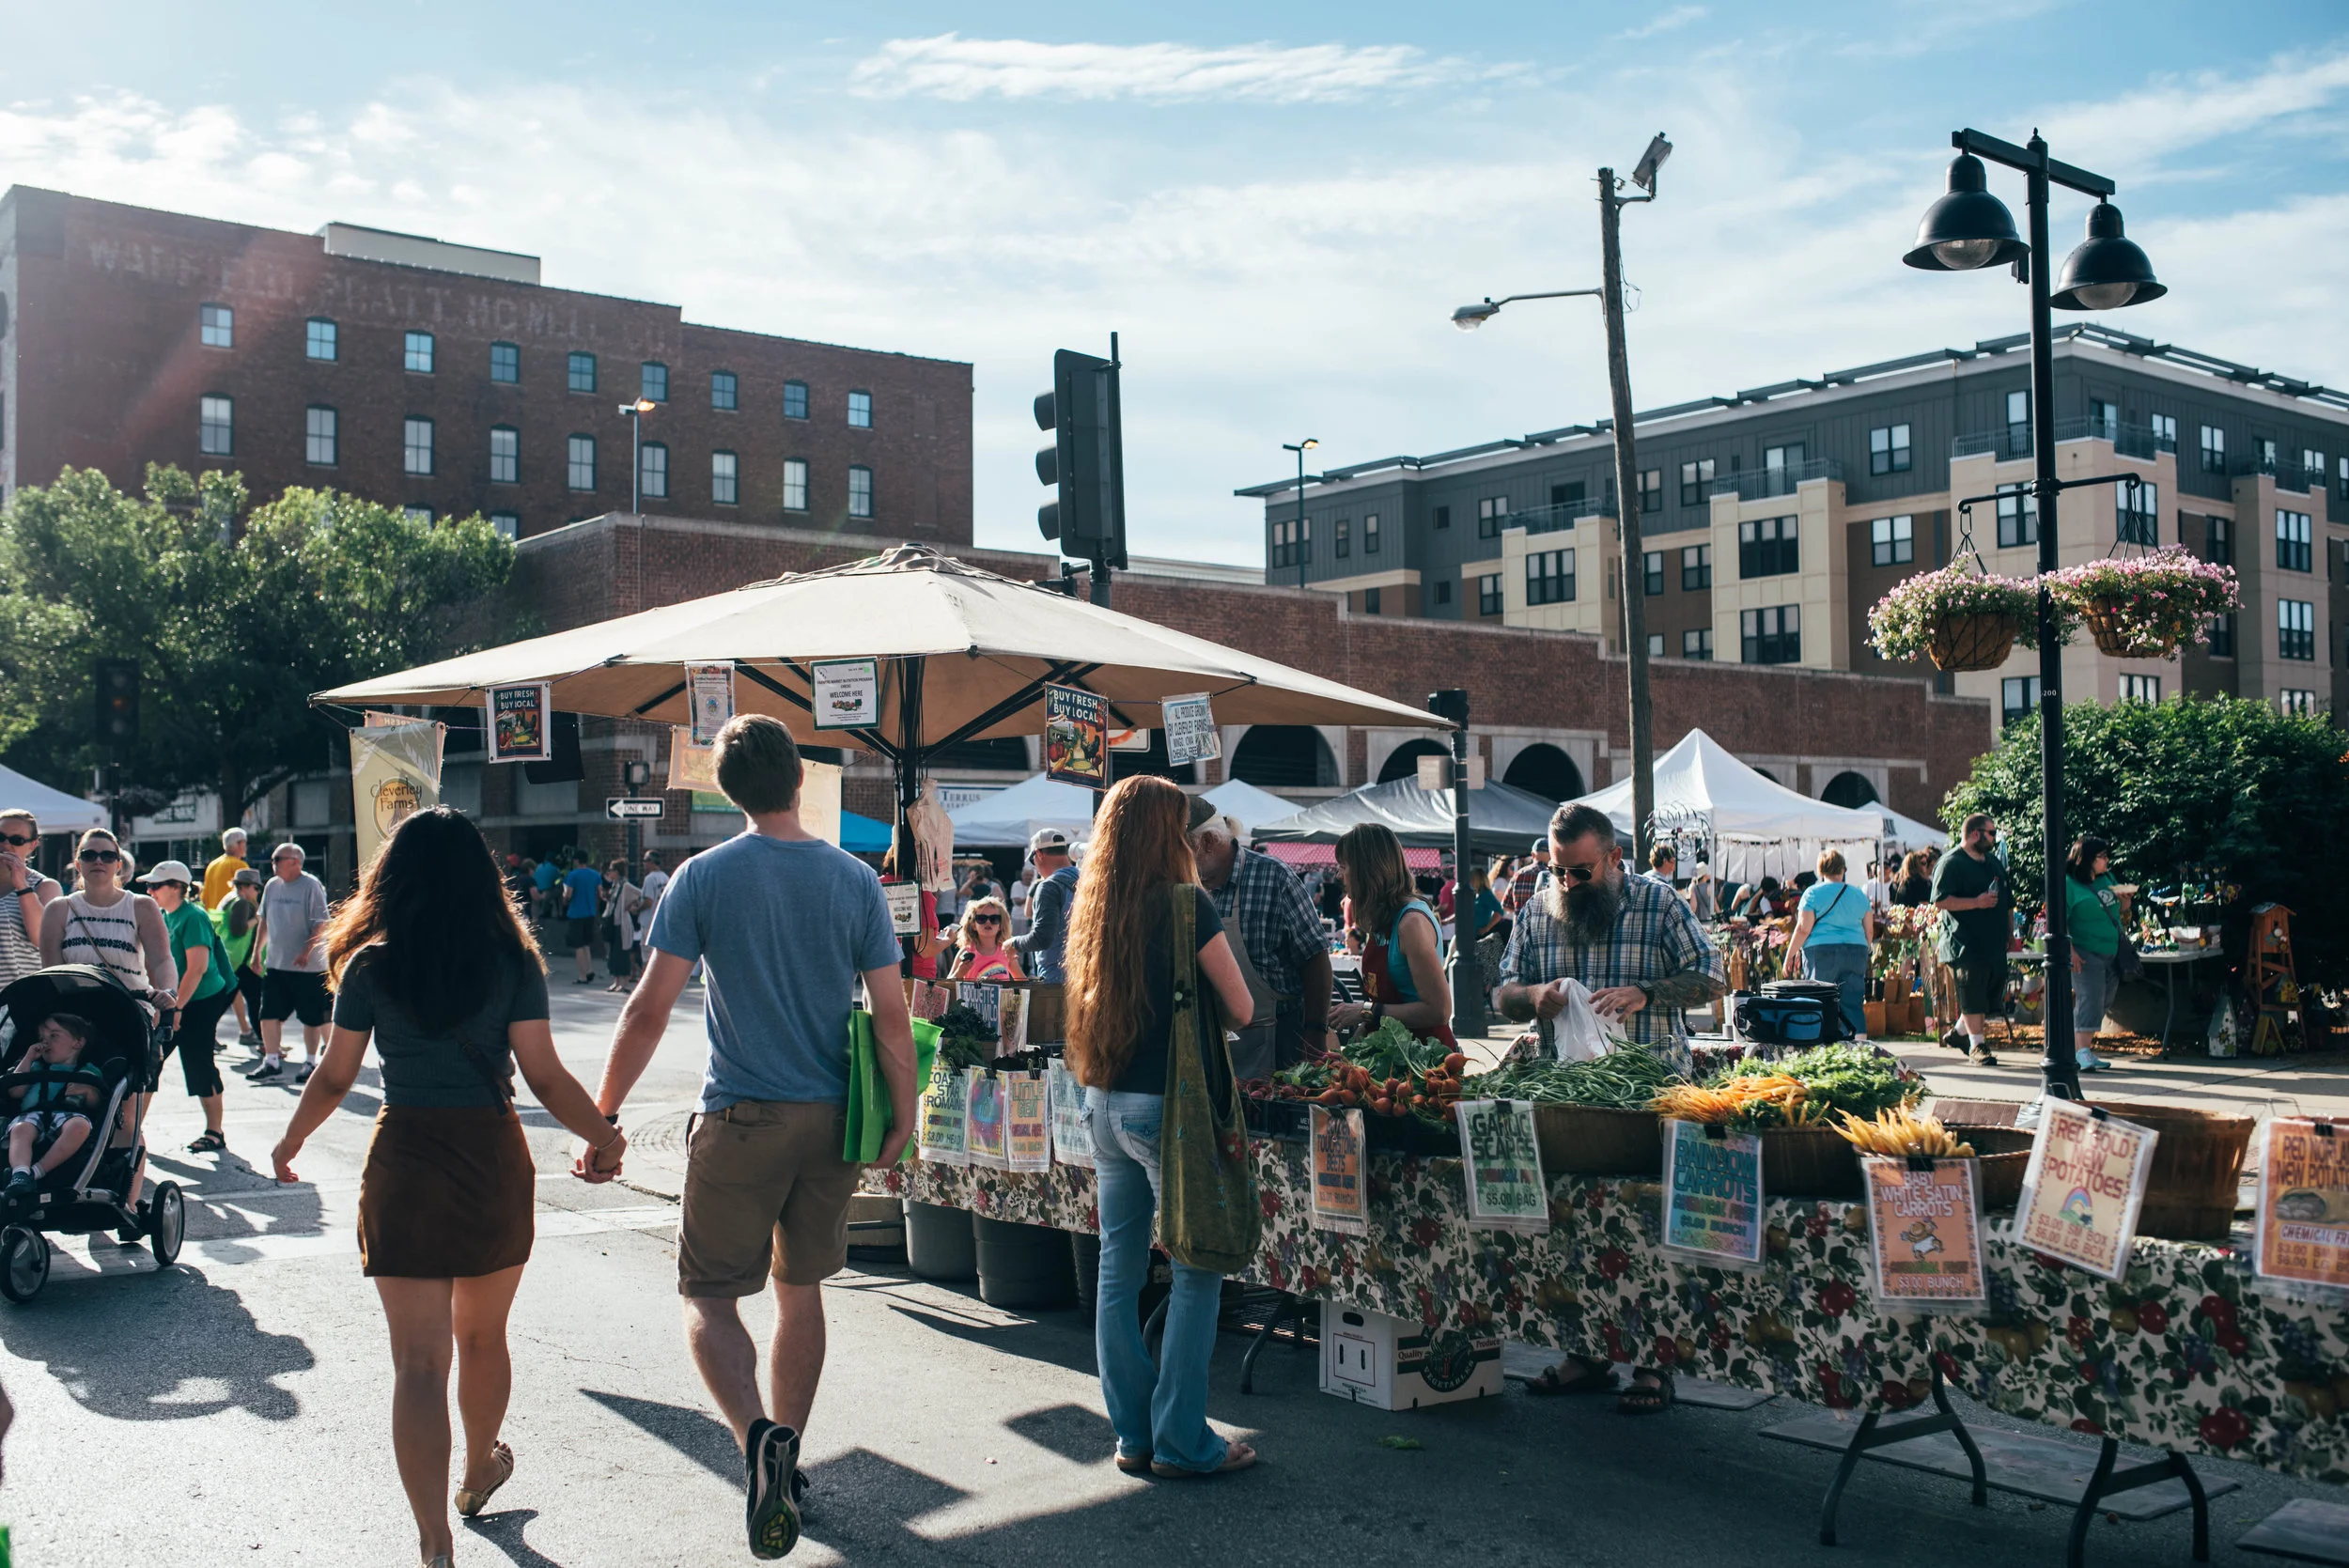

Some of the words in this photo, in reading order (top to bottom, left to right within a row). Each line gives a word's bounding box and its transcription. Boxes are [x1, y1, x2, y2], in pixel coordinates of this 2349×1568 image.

[500, 691, 513, 700] BUY
[514, 690, 535, 698] FRESH
[829, 691, 851, 699] WELCOME
[1053, 689, 1071, 703] BUY
[1072, 692, 1098, 710] FRESH
[501, 701, 514, 710] BUY
[514, 700, 536, 708] LOCAL
[1053, 703, 1071, 716] BUY
[1072, 706, 1098, 723] LOCAL
[1193, 718, 1207, 733] FARMS
[1189, 745, 1198, 756] FREE
[369, 778, 423, 810] Cleverley
[380, 798, 415, 813] Farms
[624, 804, 638, 813] ONE
[642, 803, 658, 813] WAY
[938, 1084, 959, 1098] STAR
[1013, 1081, 1044, 1100] LITTLE
[927, 1095, 965, 1111] ROMAINE
[1018, 1099, 1038, 1118] GEM
[1471, 1112, 1531, 1137] GARLIC
[2056, 1118, 2085, 1144] RED
[2089, 1130, 2130, 1158] GOLD
[1470, 1137, 1536, 1162] SCAPES
[2283, 1135, 2306, 1161] RED
[1674, 1139, 1757, 1178] RAINBOW
[2071, 1144, 2108, 1172] NEW
[1903, 1171, 1935, 1188] BABY
[2046, 1157, 2124, 1200] POTATOES
[2277, 1160, 2306, 1187] NEW
[1673, 1165, 1757, 1204] CARROTS
[1486, 1191, 1513, 1207] $5.00
[1517, 1193, 1536, 1207] BAG
[1880, 1185, 1921, 1203] WHITE
[1924, 1185, 1965, 1203] SATIN
[1894, 1201, 1954, 1218] CARROTS
[2038, 1213, 2063, 1231] $3.00
[2086, 1230, 2108, 1246] BOX
[2283, 1226, 2331, 1243] CHEMICAL
[2277, 1242, 2307, 1256] $3.00
[1927, 1276, 1965, 1288] BUNCH
[1398, 1350, 1423, 1361] Quality
[1476, 1338, 1501, 1349] Produce
